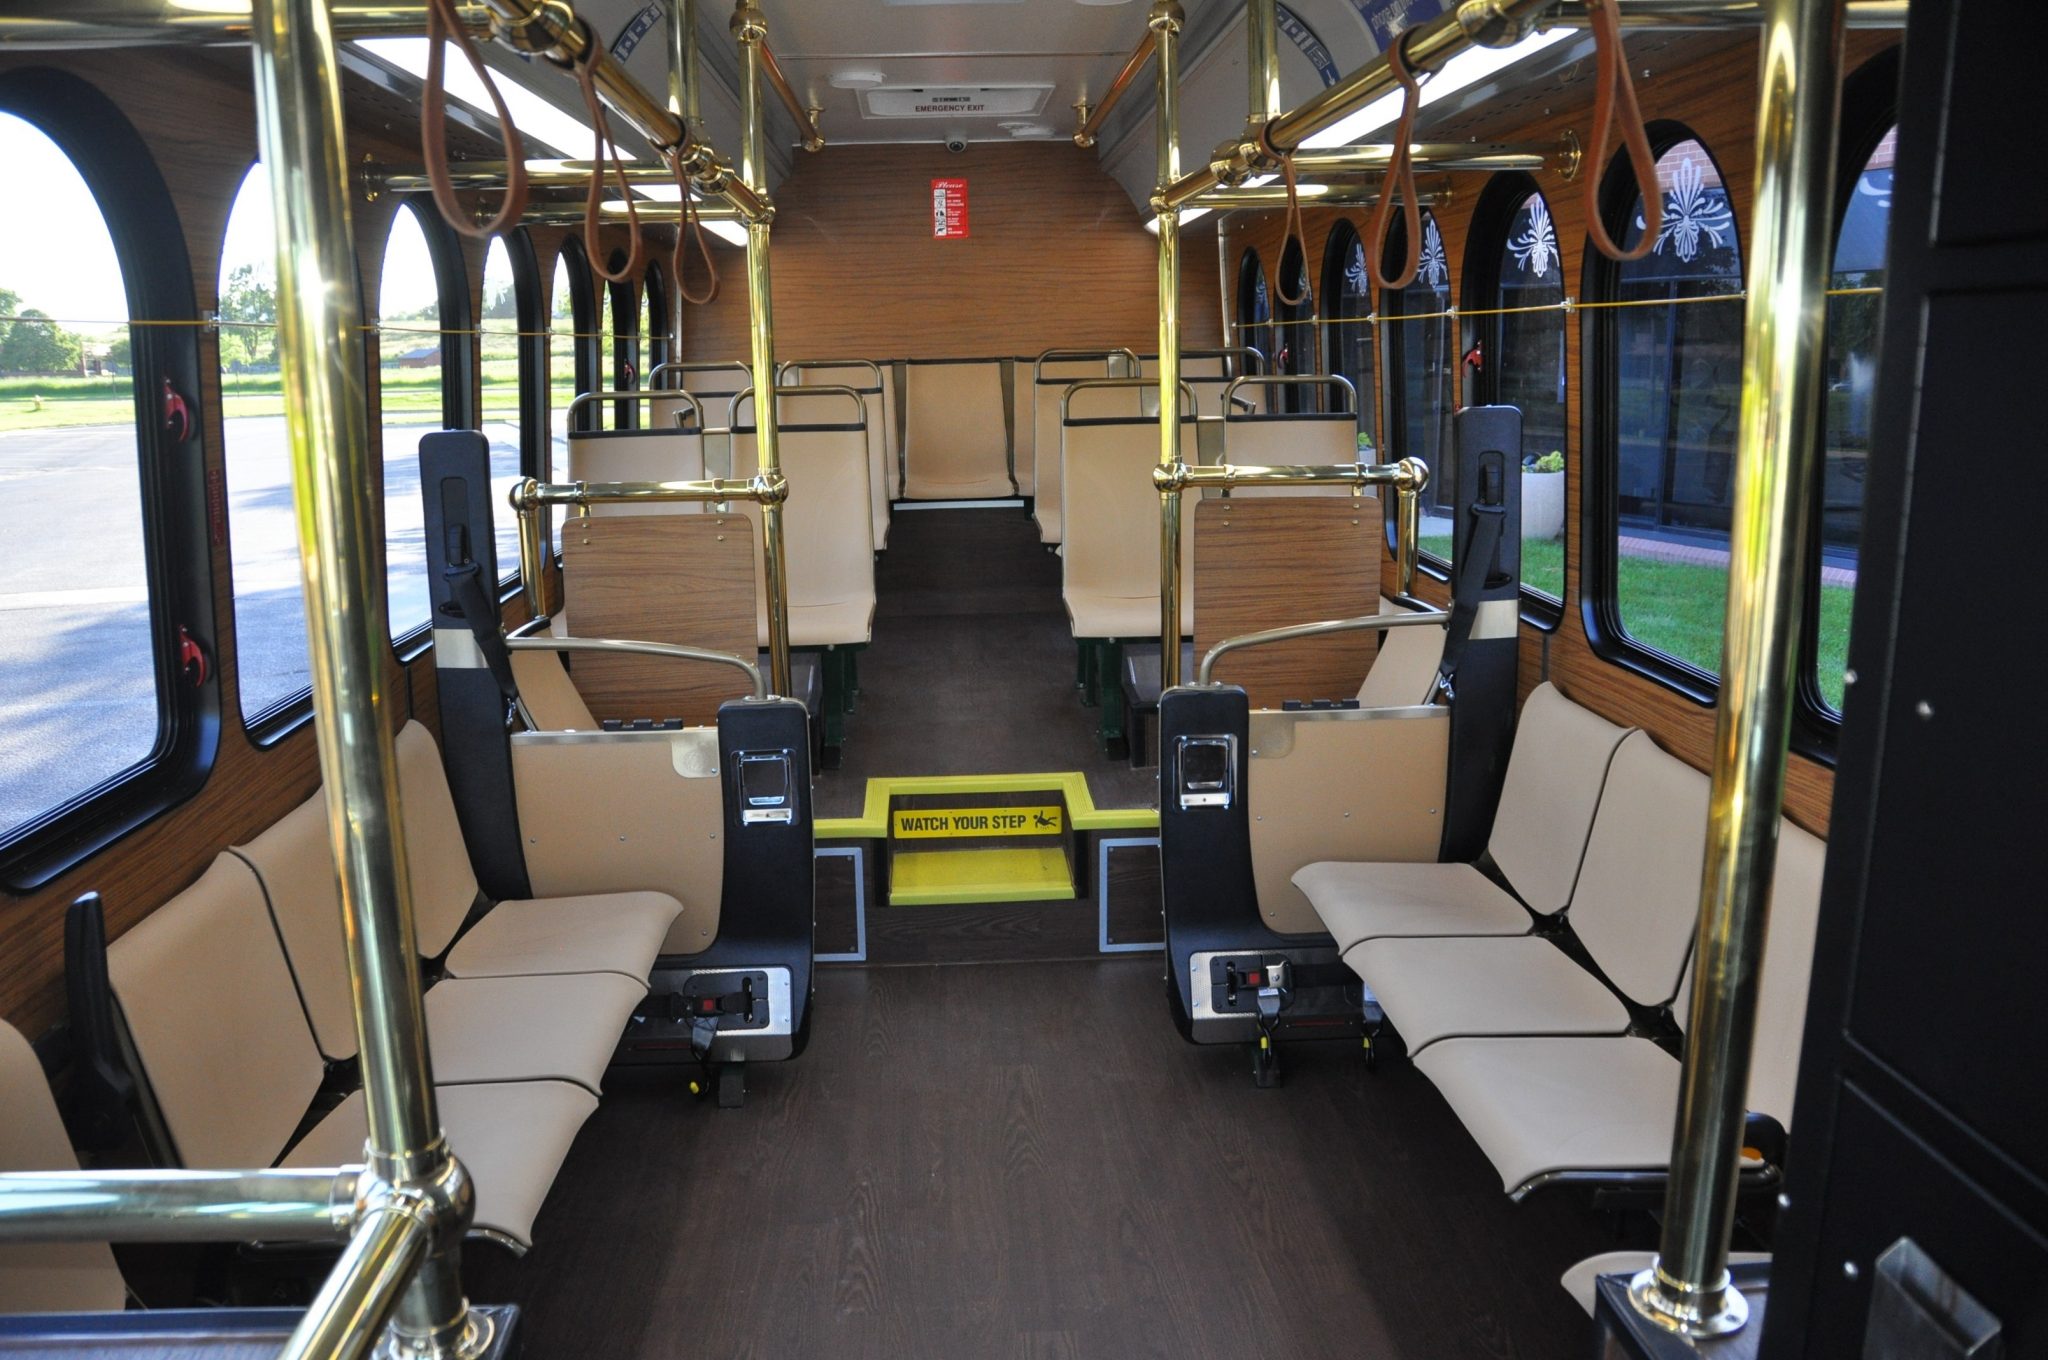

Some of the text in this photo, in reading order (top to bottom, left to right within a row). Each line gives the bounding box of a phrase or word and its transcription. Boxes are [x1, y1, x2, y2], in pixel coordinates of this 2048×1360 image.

[967, 104, 984, 112] EXIT
[935, 181, 963, 189] Please
[901, 815, 1026, 831] WATCH YOUR STEP
